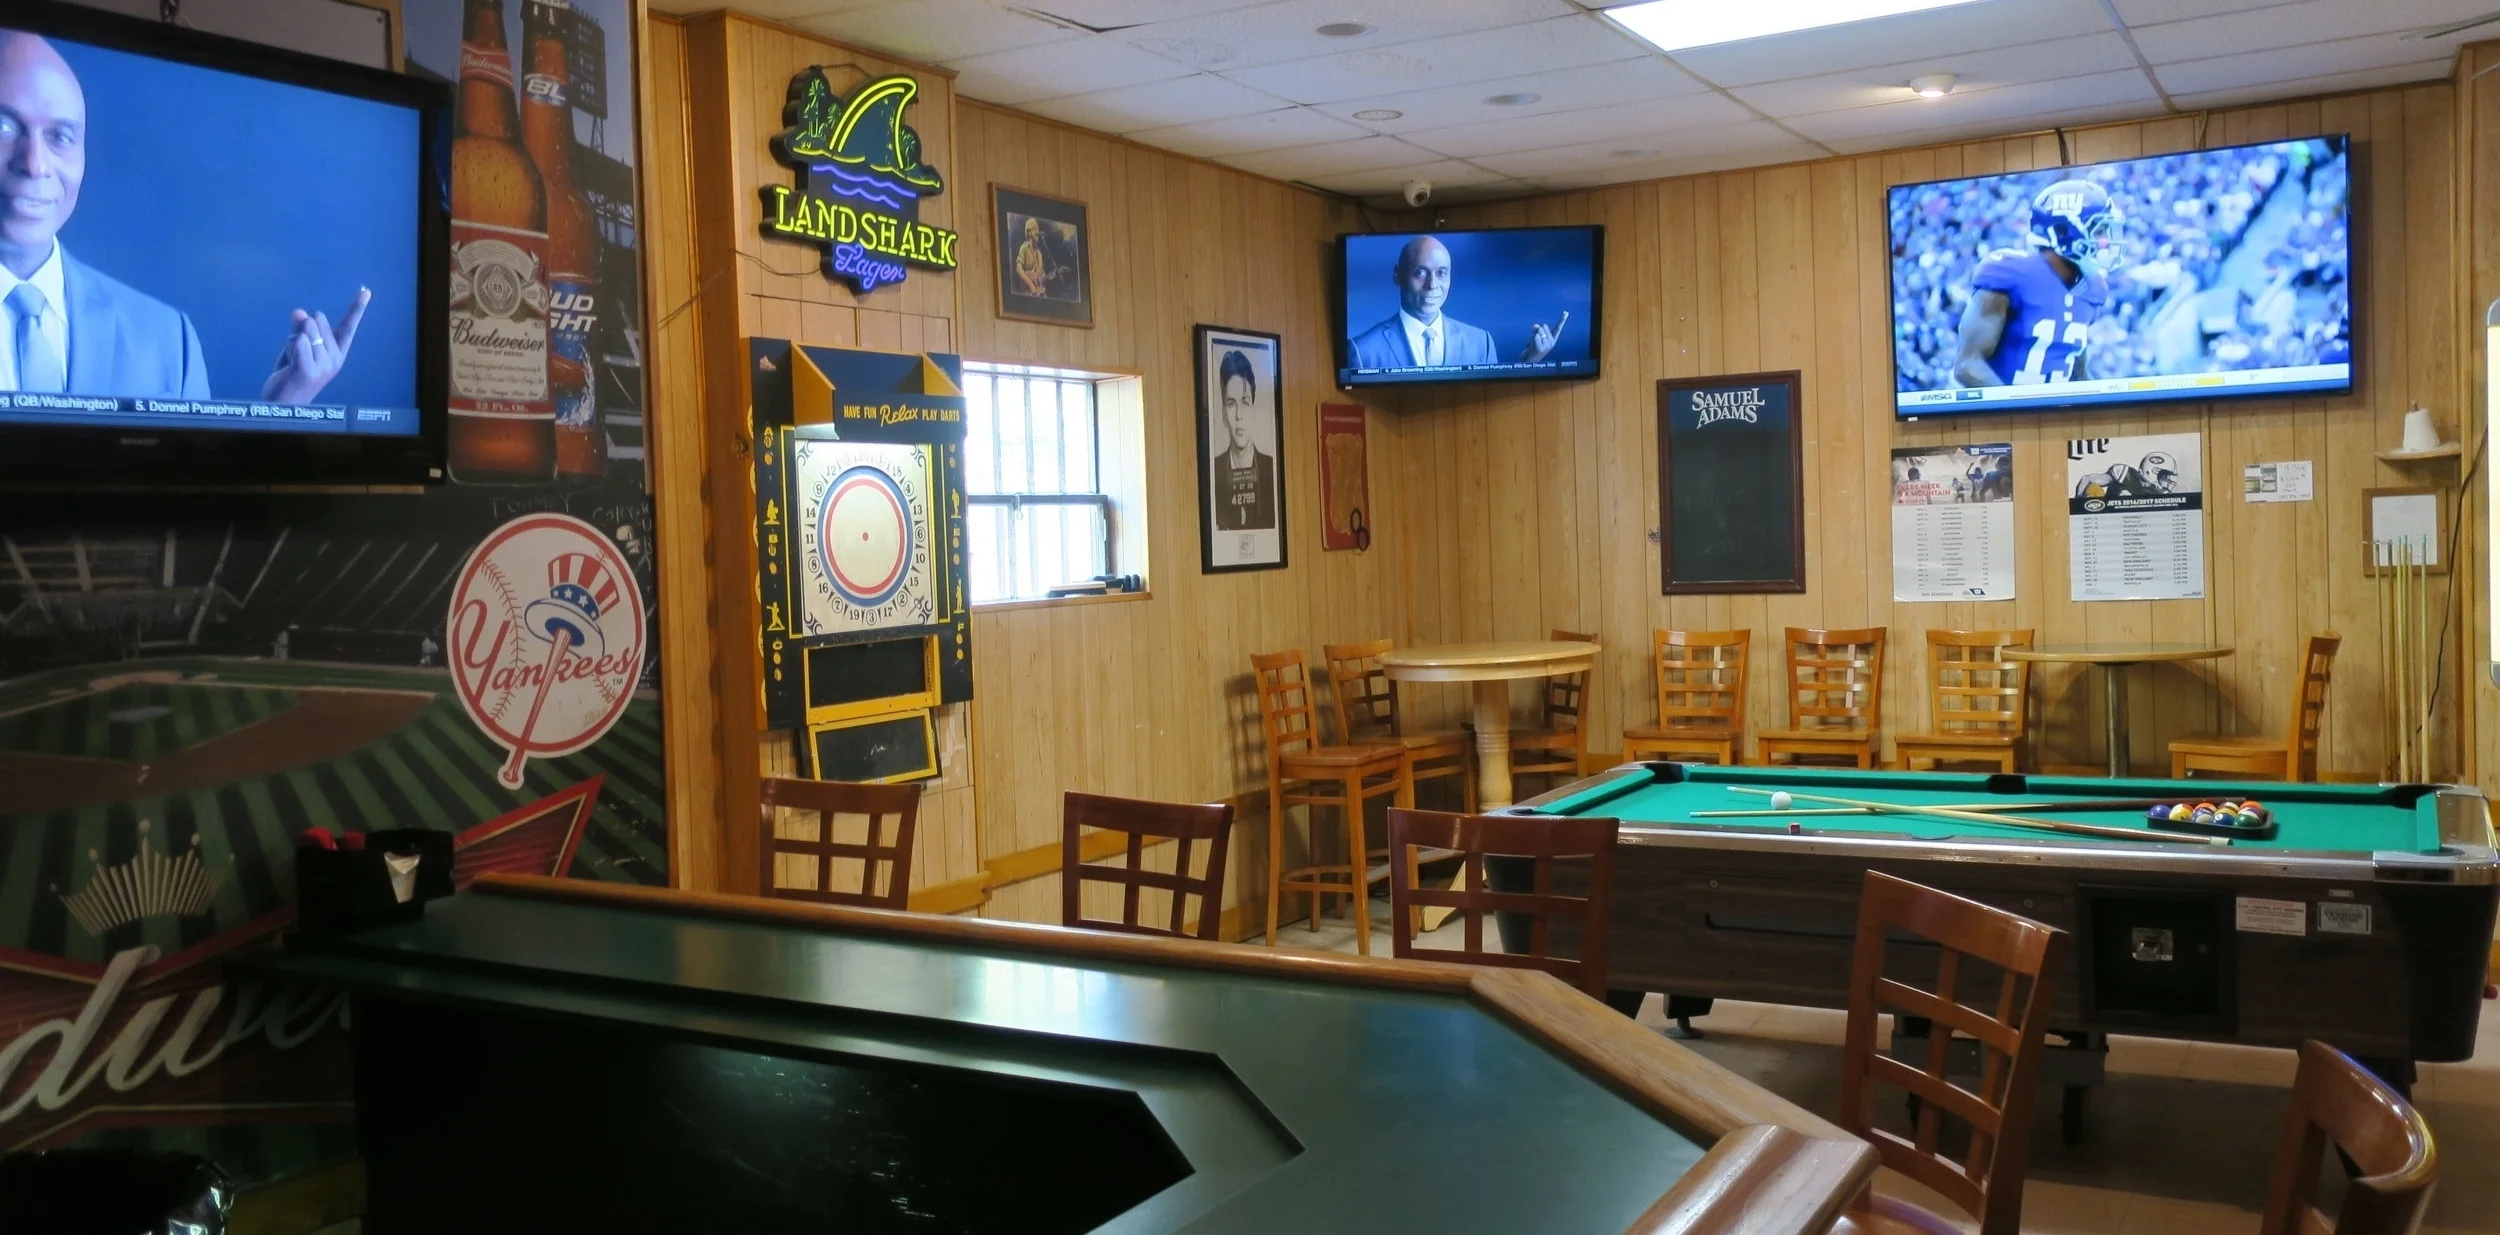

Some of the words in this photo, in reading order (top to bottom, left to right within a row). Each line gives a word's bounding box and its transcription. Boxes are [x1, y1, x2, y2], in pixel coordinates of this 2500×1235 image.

[775, 186, 958, 268] LANDSHARK
[835, 243, 905, 290] Lager
[550, 290, 594, 311] UD
[550, 313, 597, 332] GHT
[450, 317, 545, 351] Budweiser
[14, 394, 119, 412] (QB/Washington)
[1692, 388, 1765, 411] SAMUEL
[136, 400, 146, 411] 5.
[150, 401, 189, 413] Donnel
[192, 403, 247, 417] Pumphrey
[250, 406, 293, 418] (RB/San
[295, 408, 324, 420] Diego
[357, 409, 391, 421] ESPN
[843, 405, 860, 418] HAVE
[864, 406, 877, 419] FUN
[880, 404, 919, 428] Relax
[922, 408, 938, 421] PLAY
[940, 409, 960, 422] DARTS
[1696, 405, 1758, 429] ADAMS
[826, 465, 837, 476] 12
[892, 465, 902, 477] 18
[806, 508, 816, 518] 14
[913, 504, 922, 515] 13
[806, 534, 814, 544] 11
[916, 554, 926, 564] 10
[818, 583, 828, 594] 16
[910, 576, 919, 587] 15
[850, 610, 860, 620] 19
[884, 608, 893, 618] 17
[453, 598, 640, 706] Yankees
